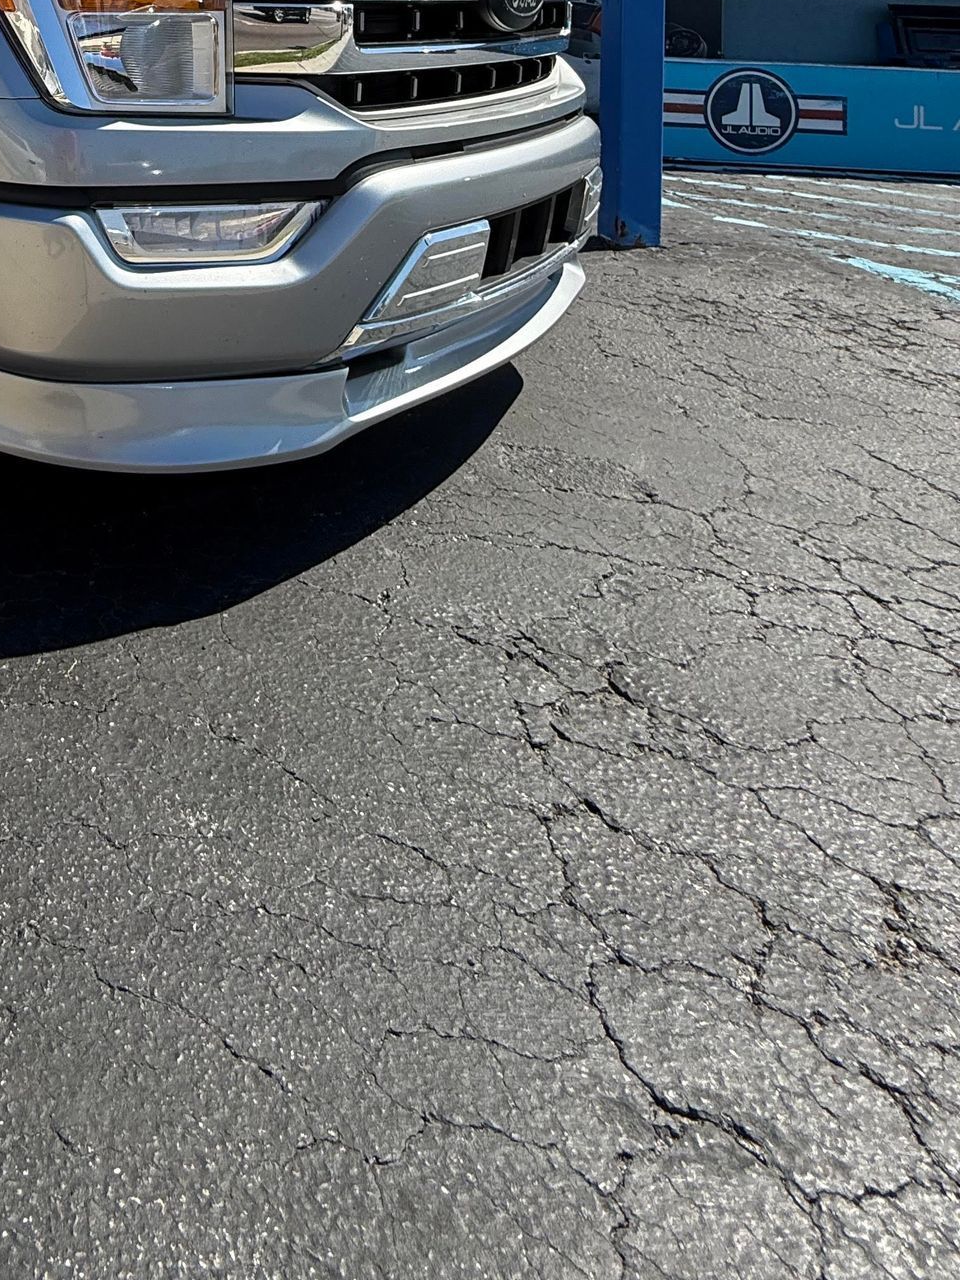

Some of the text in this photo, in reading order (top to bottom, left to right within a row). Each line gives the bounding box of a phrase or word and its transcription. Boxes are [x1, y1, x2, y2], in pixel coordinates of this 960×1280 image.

[894, 105, 943, 131] JL
[721, 125, 781, 136] JL AUDIO
